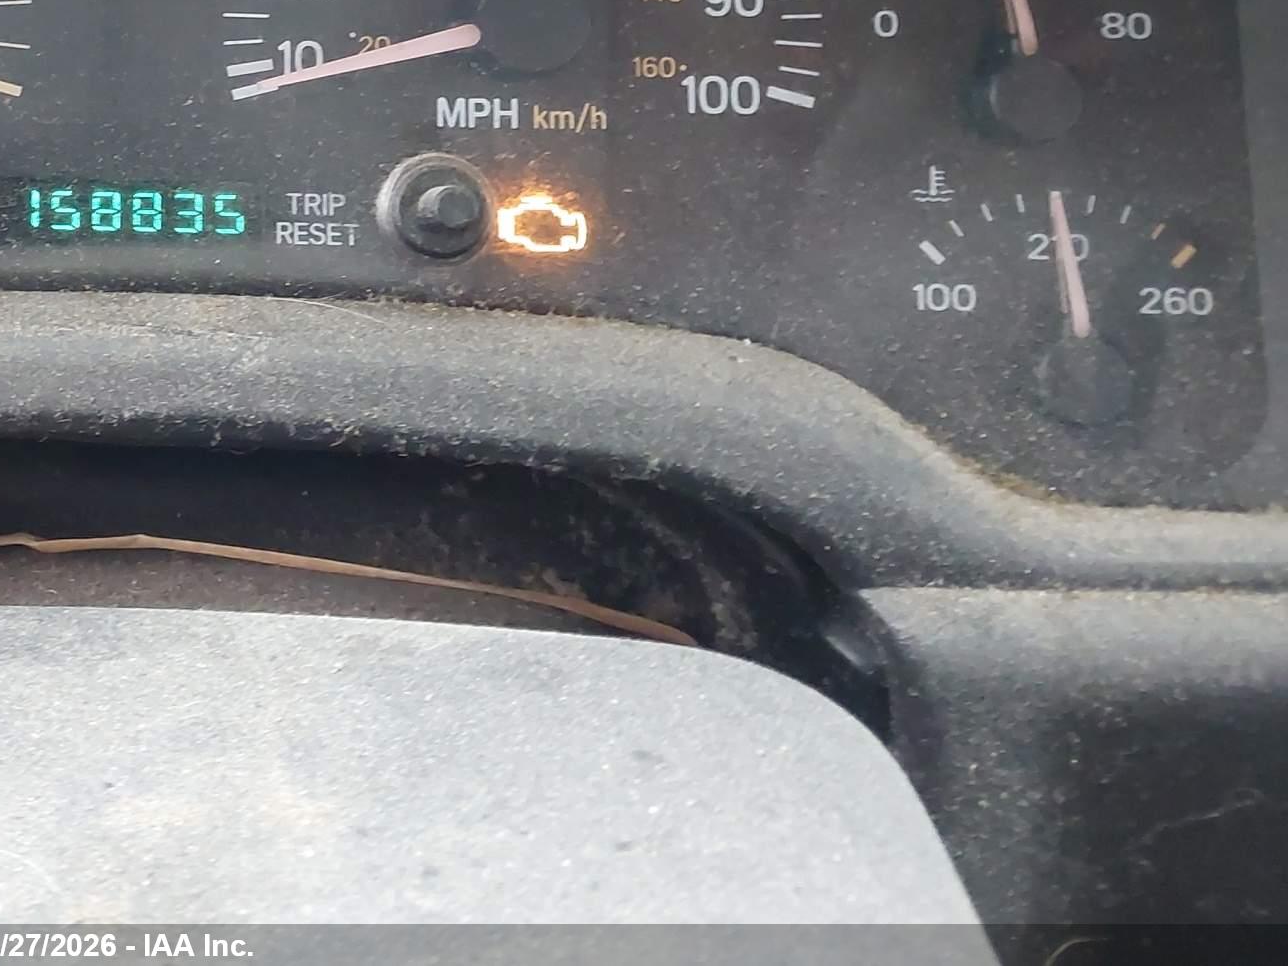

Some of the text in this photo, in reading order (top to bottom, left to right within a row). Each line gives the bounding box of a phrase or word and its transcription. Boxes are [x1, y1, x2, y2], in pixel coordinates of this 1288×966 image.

[873, 10, 899, 38] 0
[1100, 12, 1153, 40] 80
[277, 39, 323, 75] 10
[632, 57, 676, 78] 160
[680, 75, 760, 114] 100
[436, 97, 608, 133] MPH km/h
[29, 188, 245, 235] 158835
[286, 192, 346, 217] TRIP
[275, 223, 359, 248] RESET
[1027, 233, 1090, 261] 20
[912, 283, 977, 312] 100
[1138, 287, 1213, 315] 260
